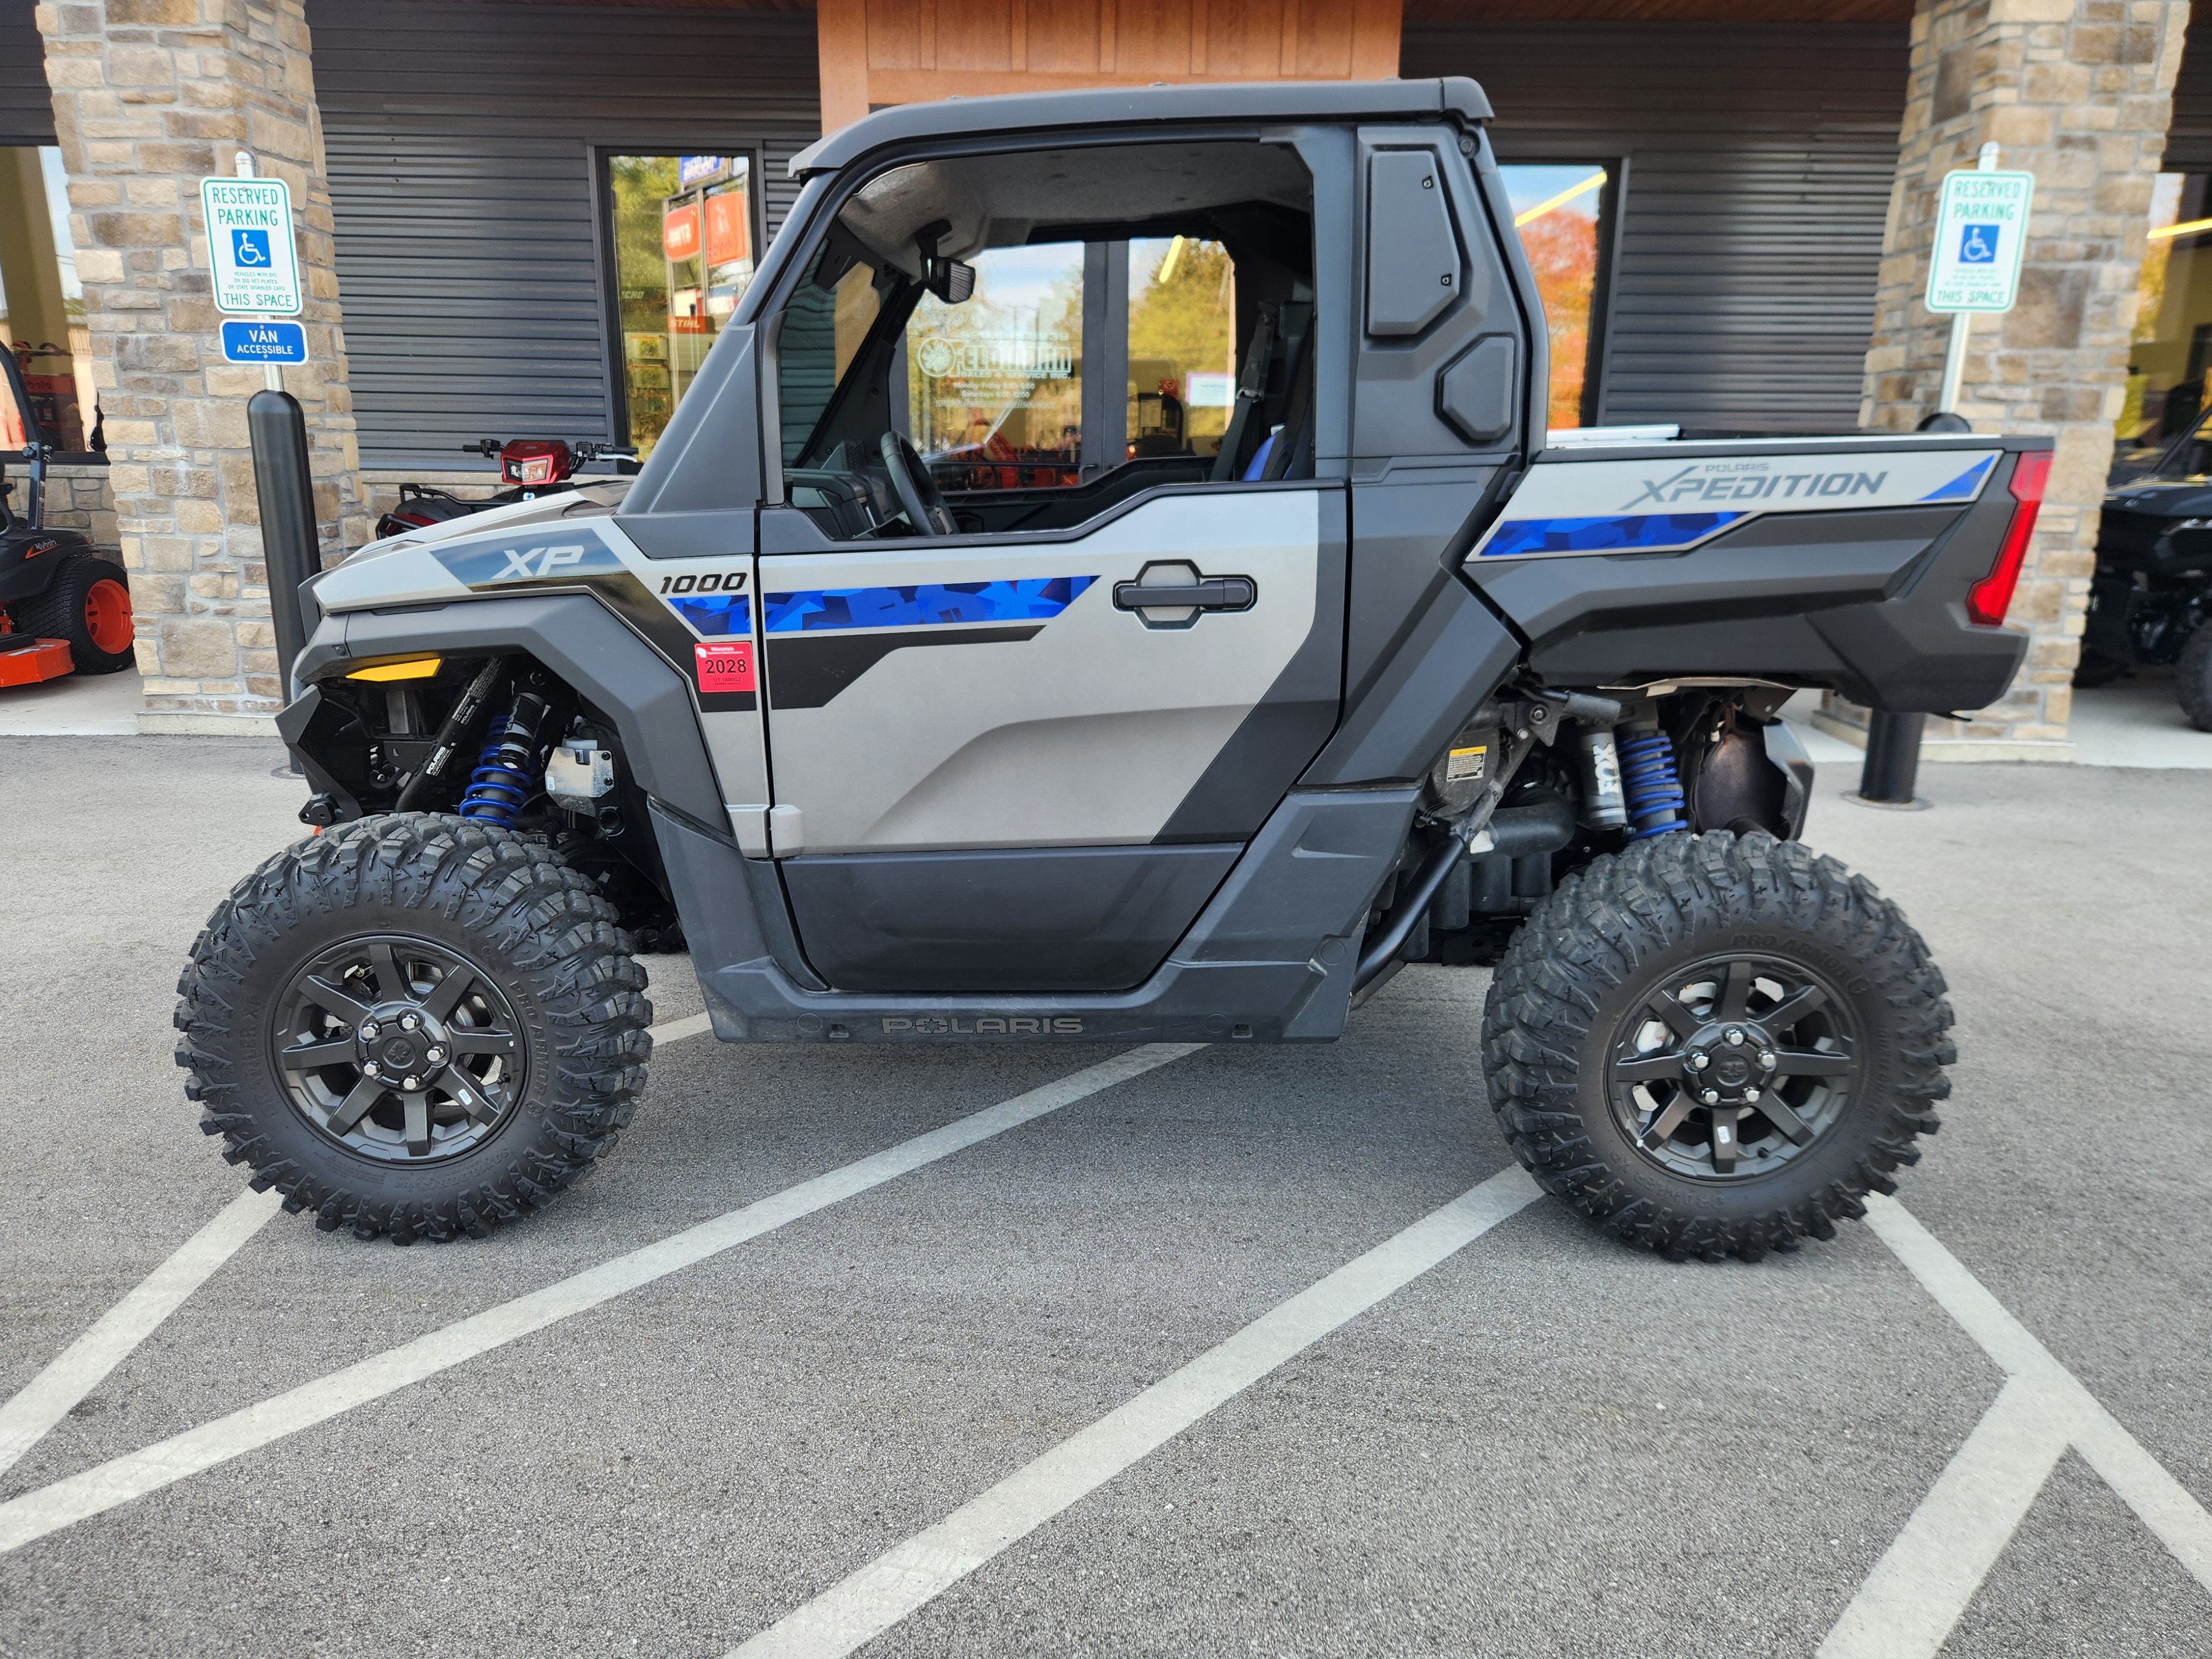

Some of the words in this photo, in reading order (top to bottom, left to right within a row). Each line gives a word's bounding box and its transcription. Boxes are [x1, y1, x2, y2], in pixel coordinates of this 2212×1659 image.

[212, 187, 278, 205] RESERVED
[1954, 181, 2021, 199] RESERVED
[218, 208, 278, 226] PARKING
[1953, 203, 2015, 220] PARKING
[224, 293, 250, 305] THIS
[256, 294, 293, 306] SPACE
[1937, 290, 1963, 302] THIS
[1967, 290, 2005, 303] SPACE
[670, 319, 701, 328] STIHL
[249, 330, 278, 343] VAN
[237, 345, 294, 354] ACCESSIBLE
[1705, 463, 1770, 473] POLARIS
[1616, 466, 1889, 512] XPEDITION
[35, 539, 57, 550] Kubota
[491, 545, 585, 579] XP
[660, 572, 748, 594] 1000
[705, 659, 747, 674] 2028
[460, 705, 475, 724] POLARIS
[426, 746, 446, 775] POLARIS
[1593, 743, 1621, 795] FOX
[1733, 935, 1777, 946] PRO
[881, 1018, 1084, 1034] POLARIS
[509, 980, 538, 1019] PRO
[530, 1025, 549, 1096] ARMOR
